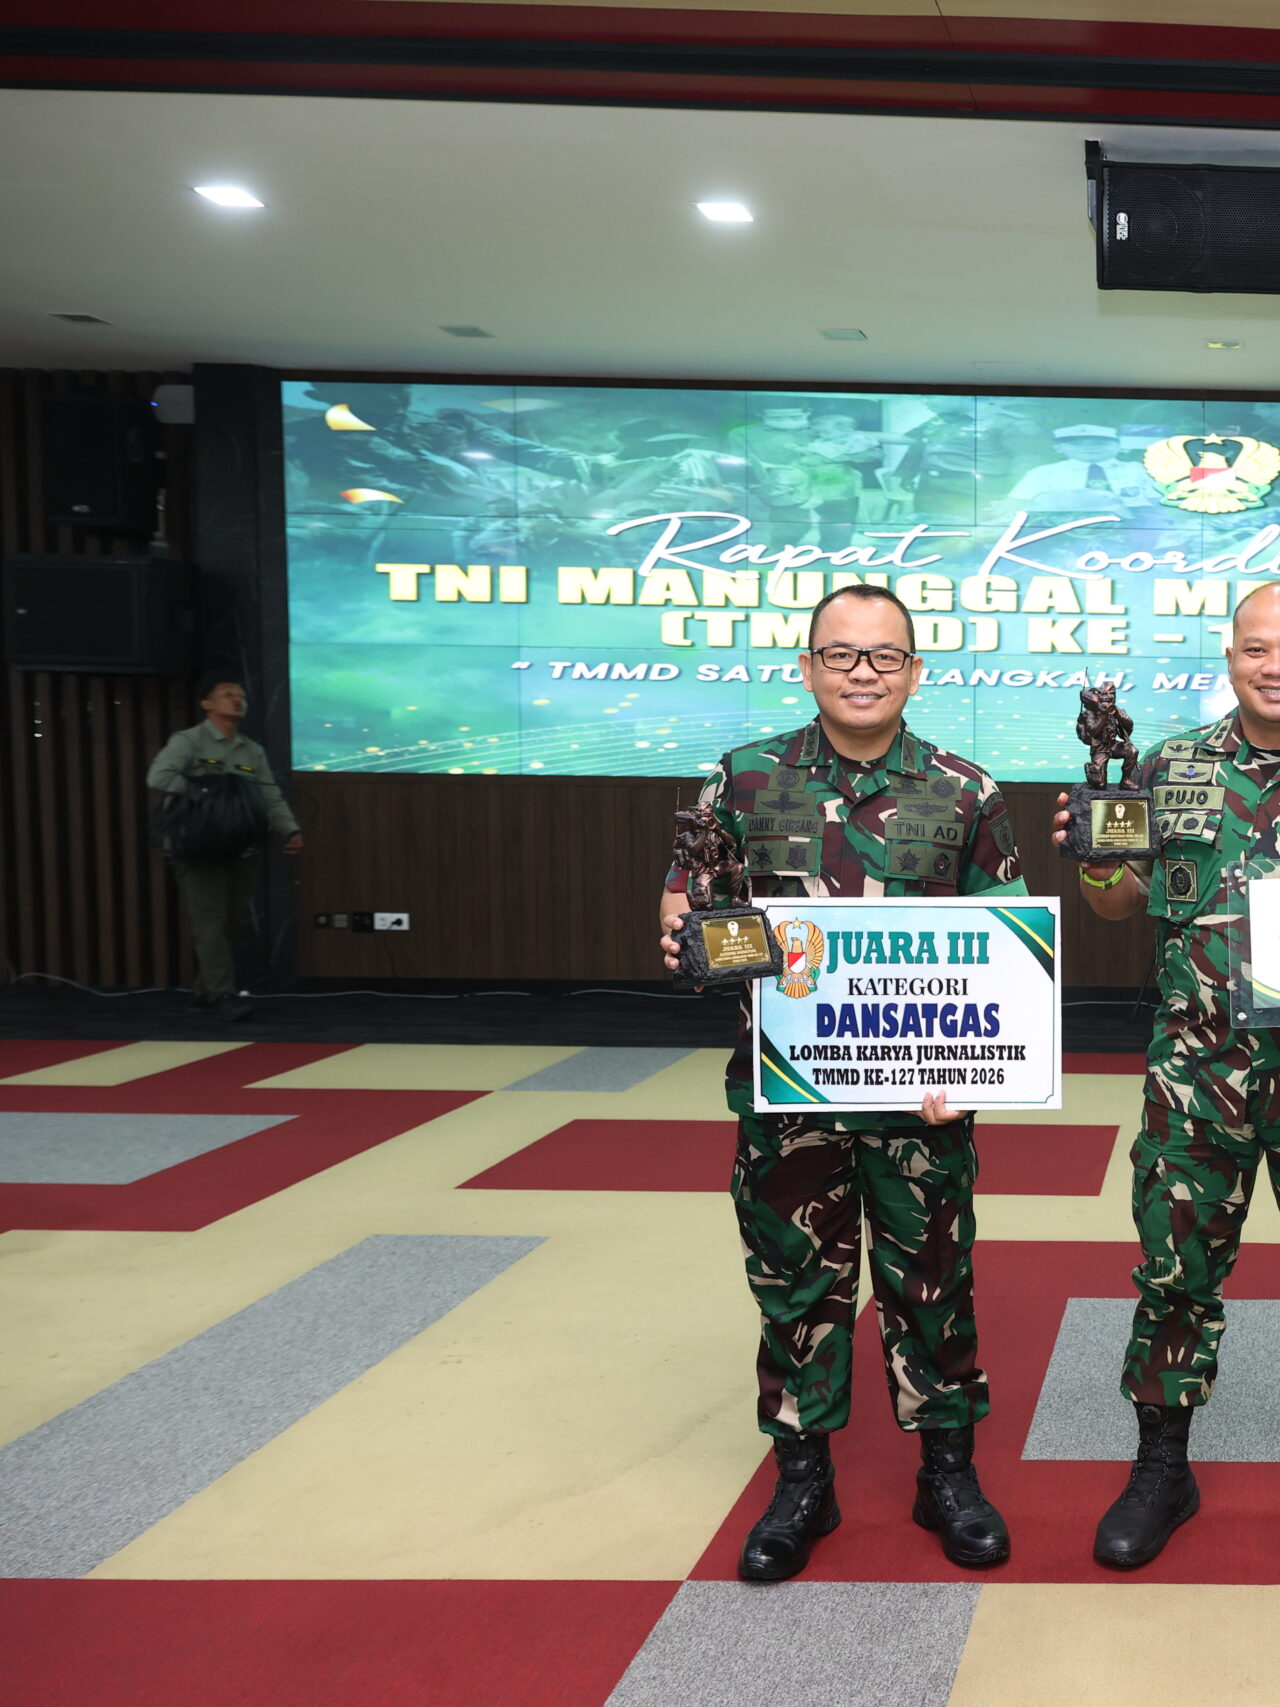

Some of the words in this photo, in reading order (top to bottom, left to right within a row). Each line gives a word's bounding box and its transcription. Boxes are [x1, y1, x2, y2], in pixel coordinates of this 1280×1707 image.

[606, 510, 971, 596] Rapat
[375, 562, 528, 604] TNI
[660, 610, 1001, 653] (TMD)
[1028, 617, 1130, 655] KE
[1153, 633, 1185, 644] -
[549, 661, 680, 682] TMMD
[696, 664, 803, 684] SATU
[919, 669, 1135, 692] LANGKAH,
[1164, 789, 1209, 806] PUJO
[892, 821, 926, 837] TNI
[933, 824, 959, 841] AD
[826, 931, 939, 974] JUARA
[946, 931, 990, 965] III
[847, 977, 969, 998] KATEGORI
[816, 1002, 1000, 1039] DANSATGAS
[789, 1045, 852, 1063] LOMBA
[856, 1045, 913, 1063] KARYA
[916, 1045, 1026, 1067] JURNALISTIK
[812, 1068, 861, 1087] TMMD
[863, 1068, 915, 1087] KE-127
[917, 1068, 967, 1086] TAHUN
[970, 1067, 1005, 1086] 2026
